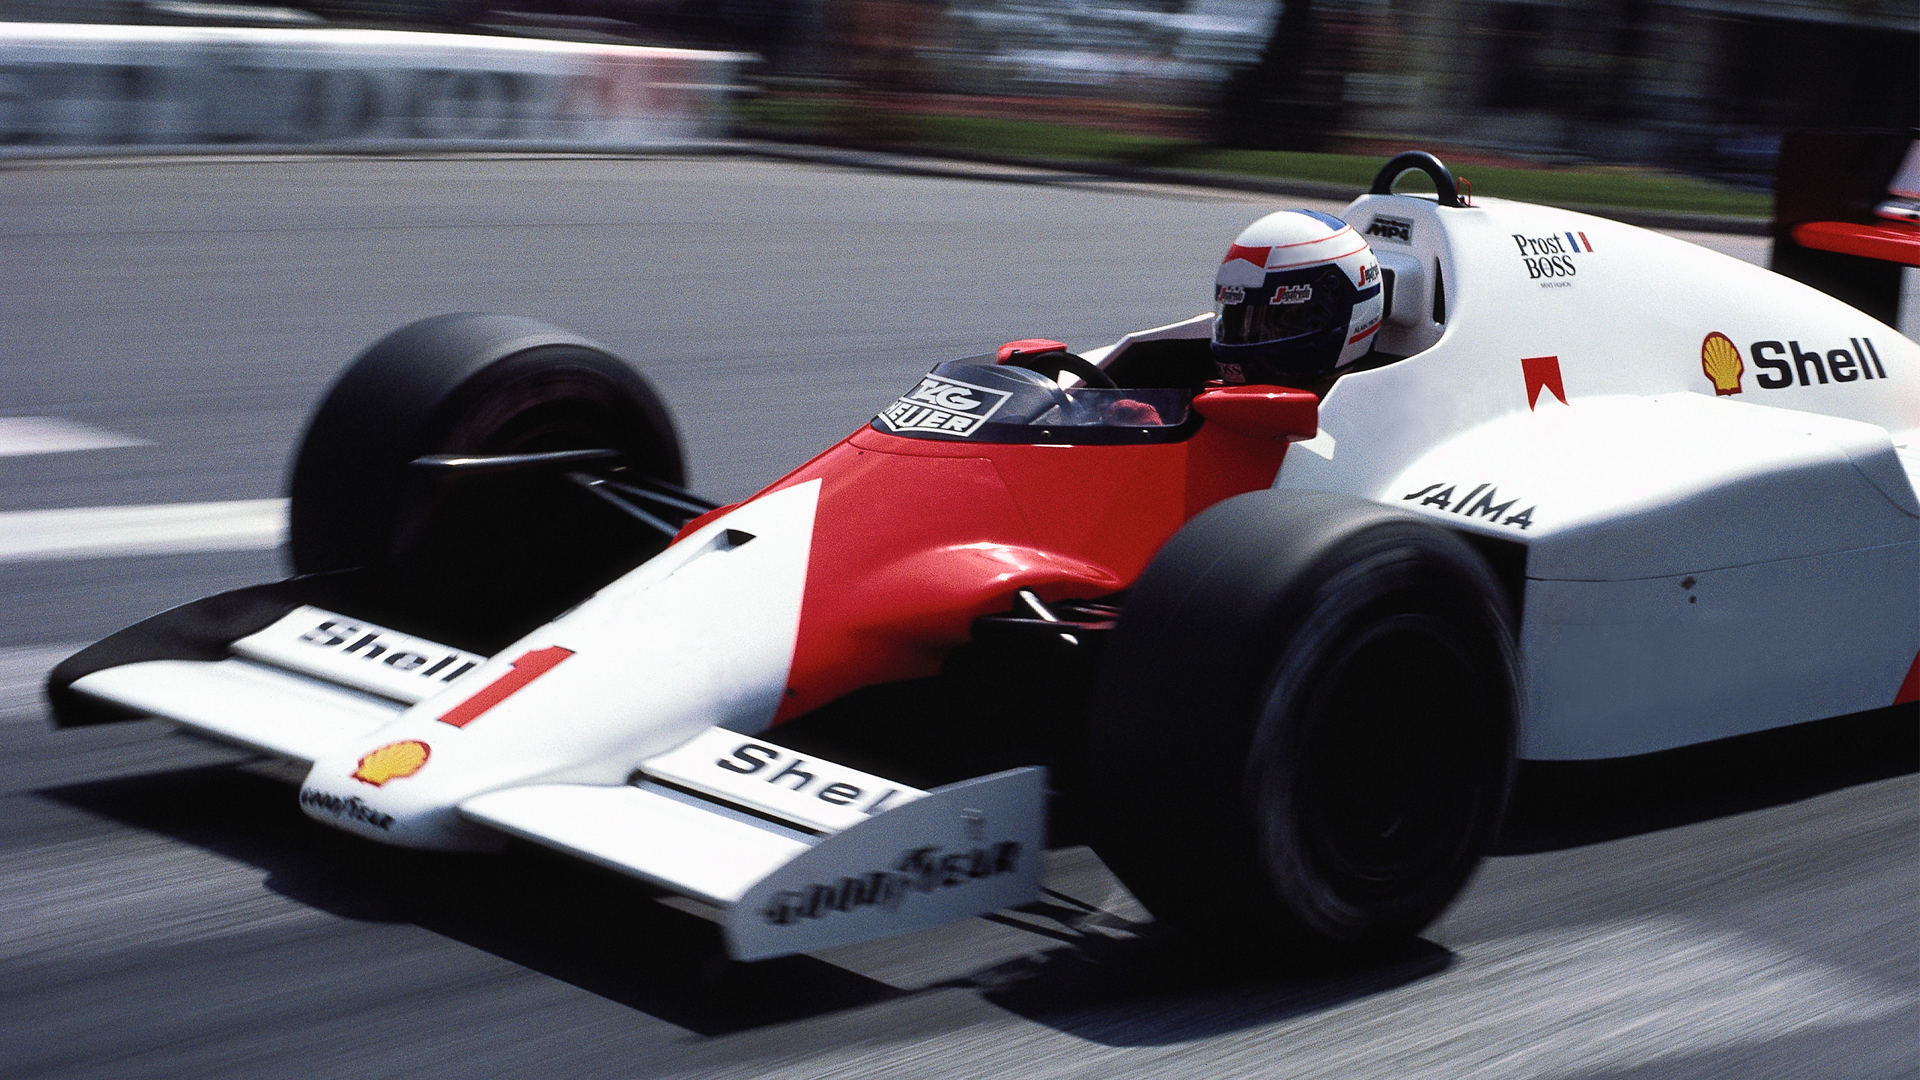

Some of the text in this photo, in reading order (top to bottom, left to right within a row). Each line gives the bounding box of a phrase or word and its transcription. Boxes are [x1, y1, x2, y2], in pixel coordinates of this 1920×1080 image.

[1511, 233, 1566, 256] Prost
[1523, 255, 1576, 279] BOSS
[1750, 337, 1888, 389] Shell
[910, 379, 981, 411] TAG
[299, 620, 477, 682] Shell
[437, 645, 577, 729] 1
[716, 743, 897, 814] Shel
